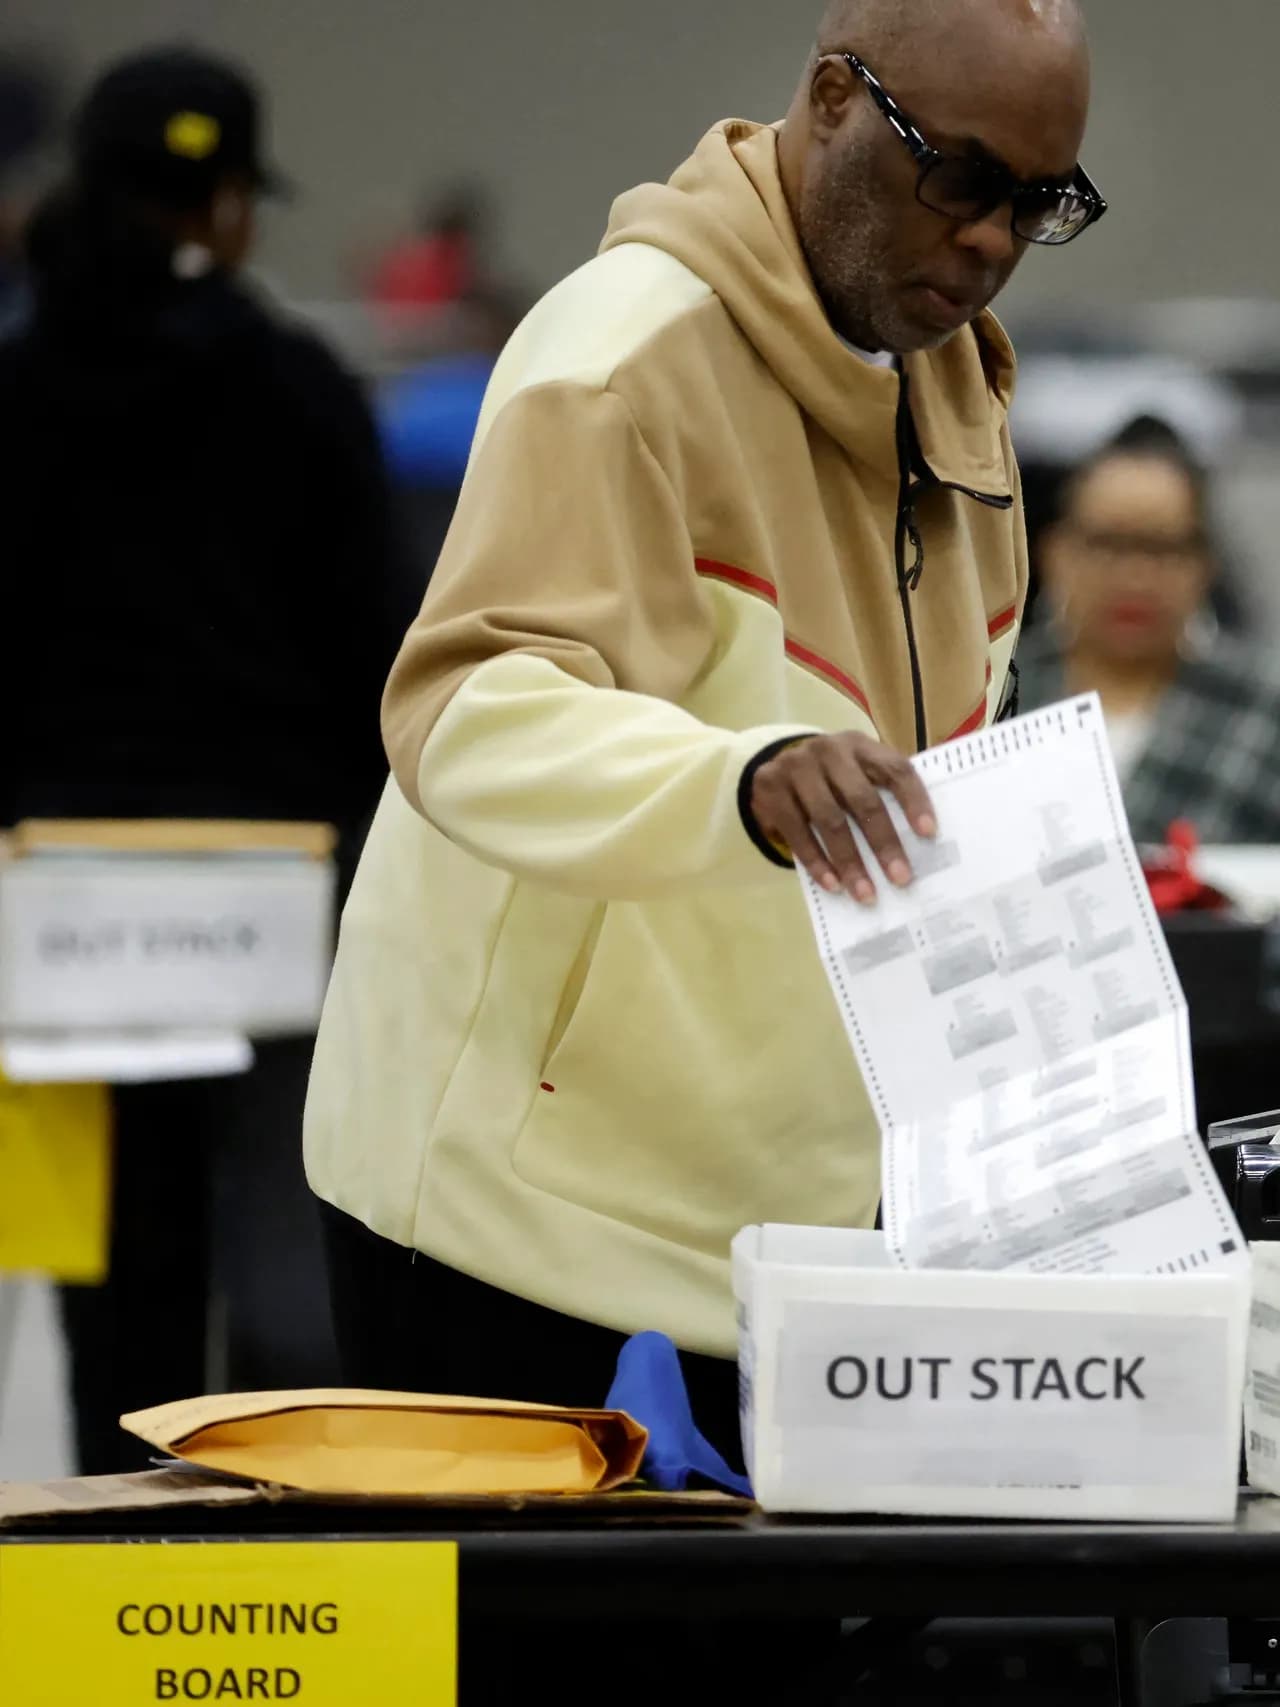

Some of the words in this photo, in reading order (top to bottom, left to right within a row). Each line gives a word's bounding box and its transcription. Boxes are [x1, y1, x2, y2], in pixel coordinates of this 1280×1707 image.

[826, 1355, 952, 1401] OUT
[970, 1356, 1146, 1401] STACK
[116, 1602, 338, 1637] COUNTING
[155, 1667, 302, 1700] BOARD
